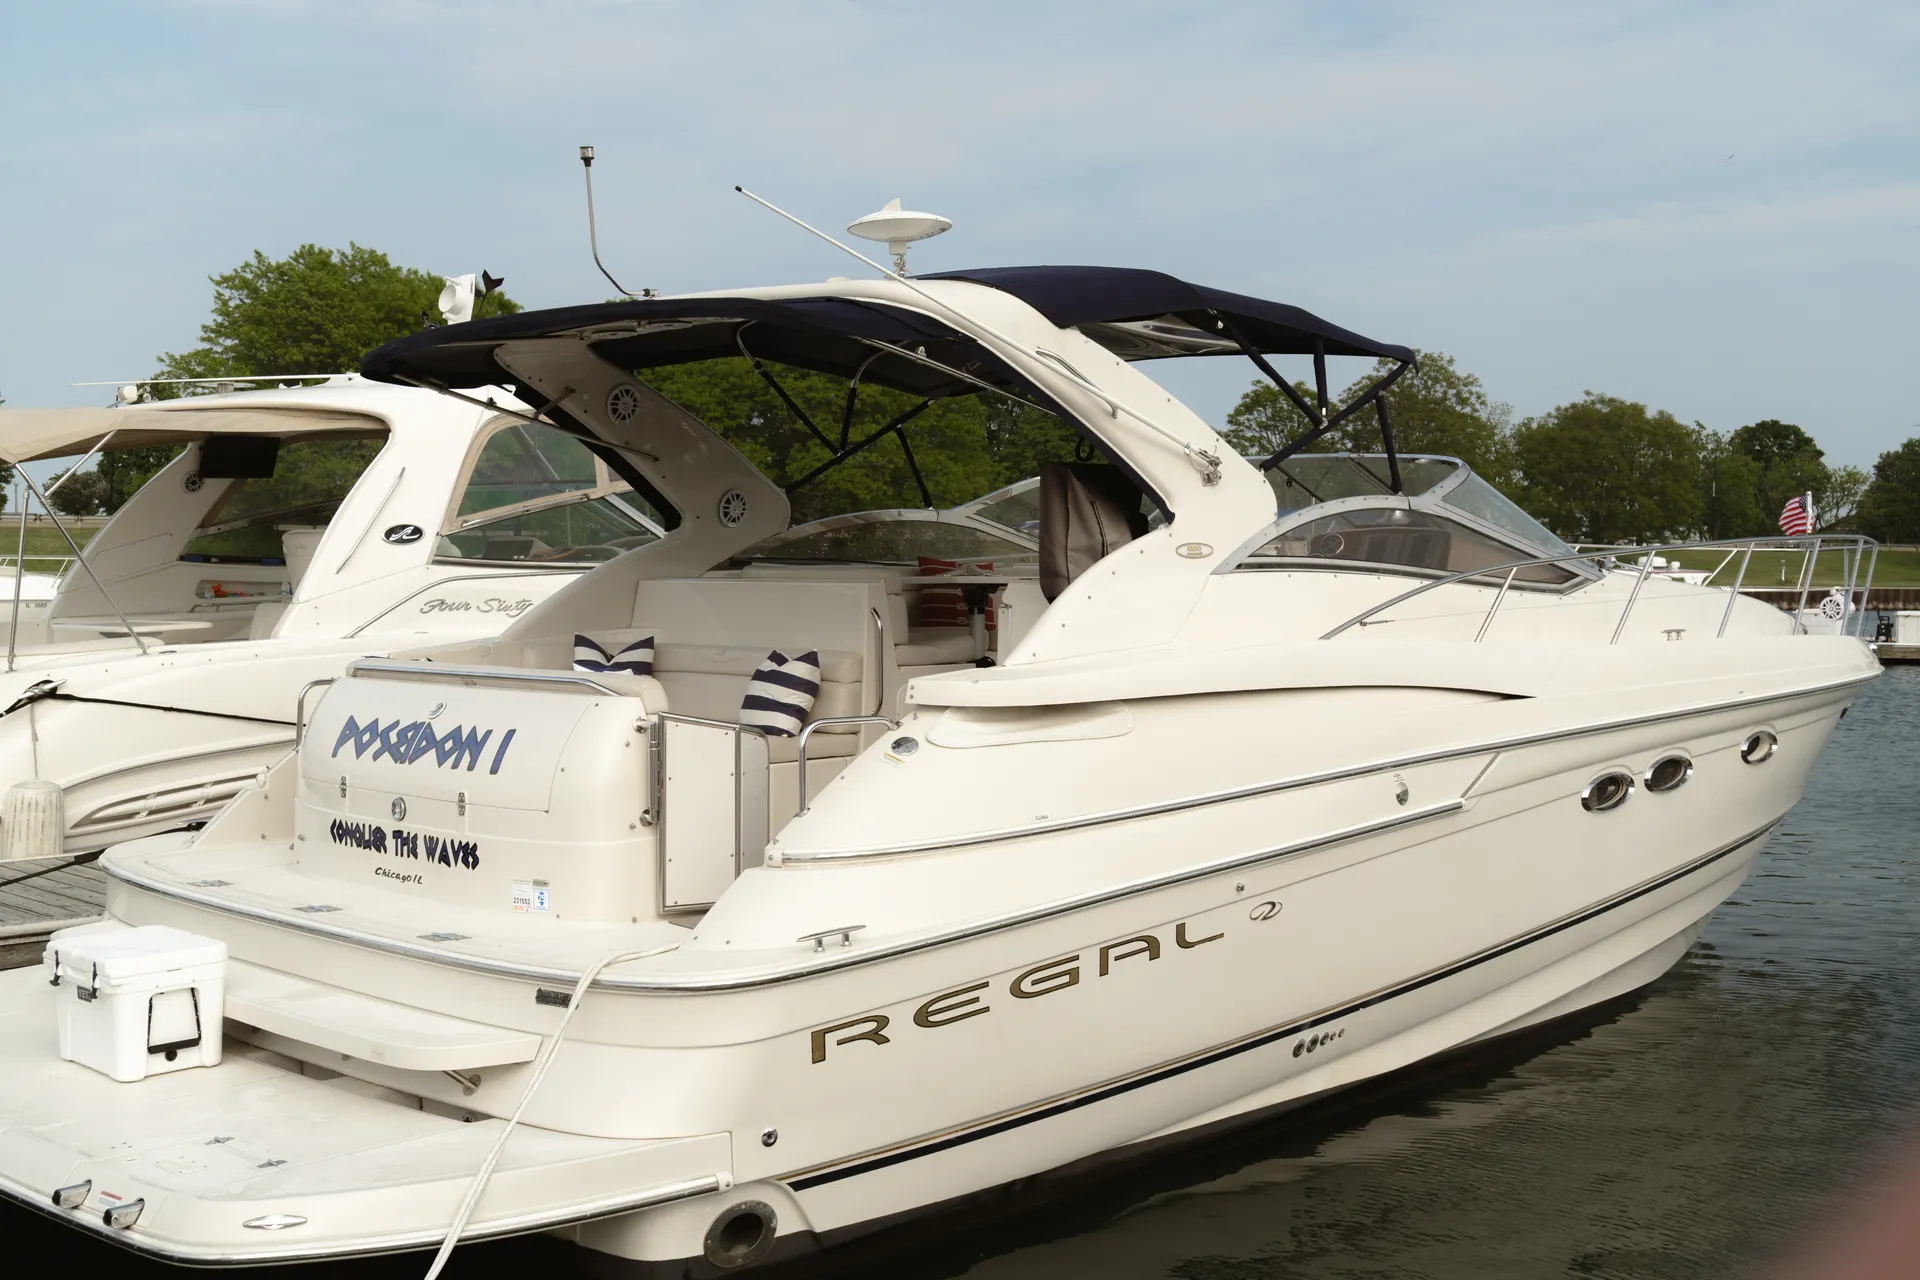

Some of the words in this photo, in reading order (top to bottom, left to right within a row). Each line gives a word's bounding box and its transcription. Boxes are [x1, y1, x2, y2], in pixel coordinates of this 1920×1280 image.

[419, 598, 472, 615] Four
[476, 597, 534, 618] Sixty
[331, 714, 493, 772] POSEIDON
[329, 817, 388, 855] CONQUER
[392, 829, 419, 860] THE
[423, 834, 480, 871] WAVES
[810, 921, 1225, 1065] REGAL
